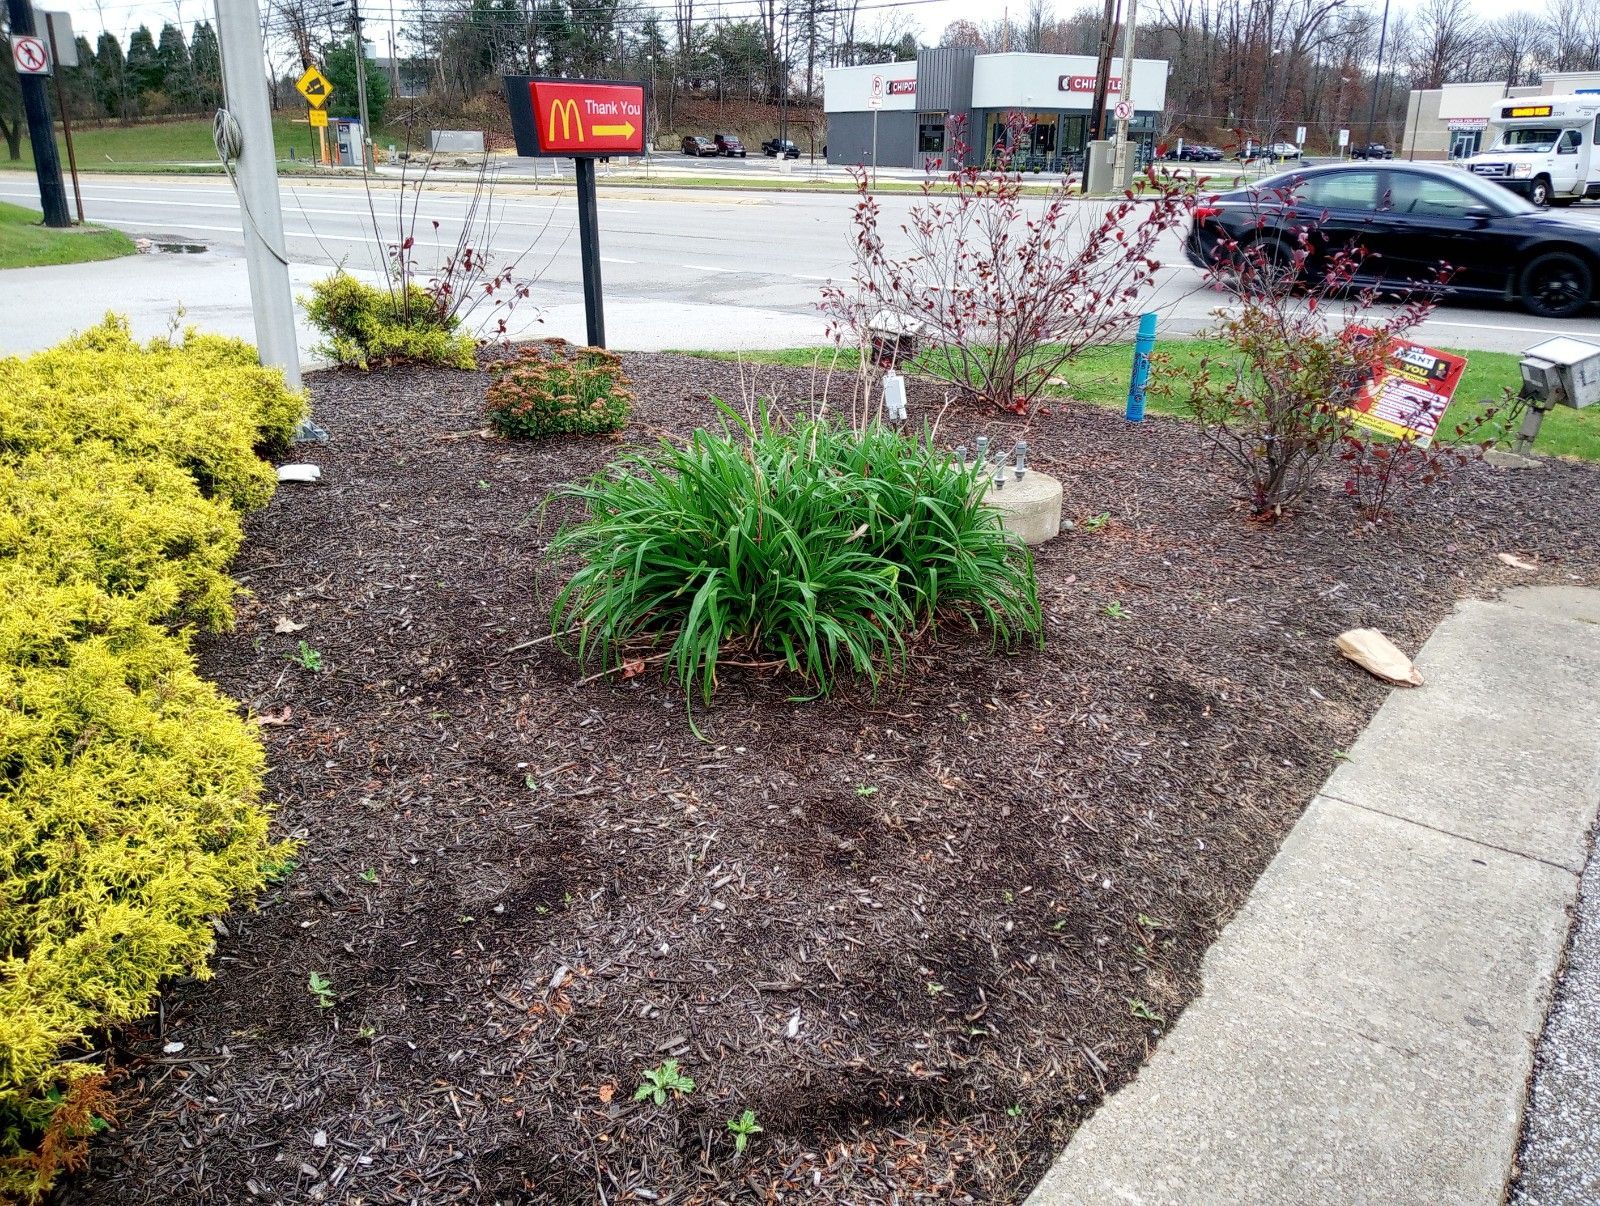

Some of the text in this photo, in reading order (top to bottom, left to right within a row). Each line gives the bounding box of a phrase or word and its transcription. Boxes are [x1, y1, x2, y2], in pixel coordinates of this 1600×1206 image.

[585, 99, 641, 116] Thank You
[1405, 363, 1429, 376] YOU
